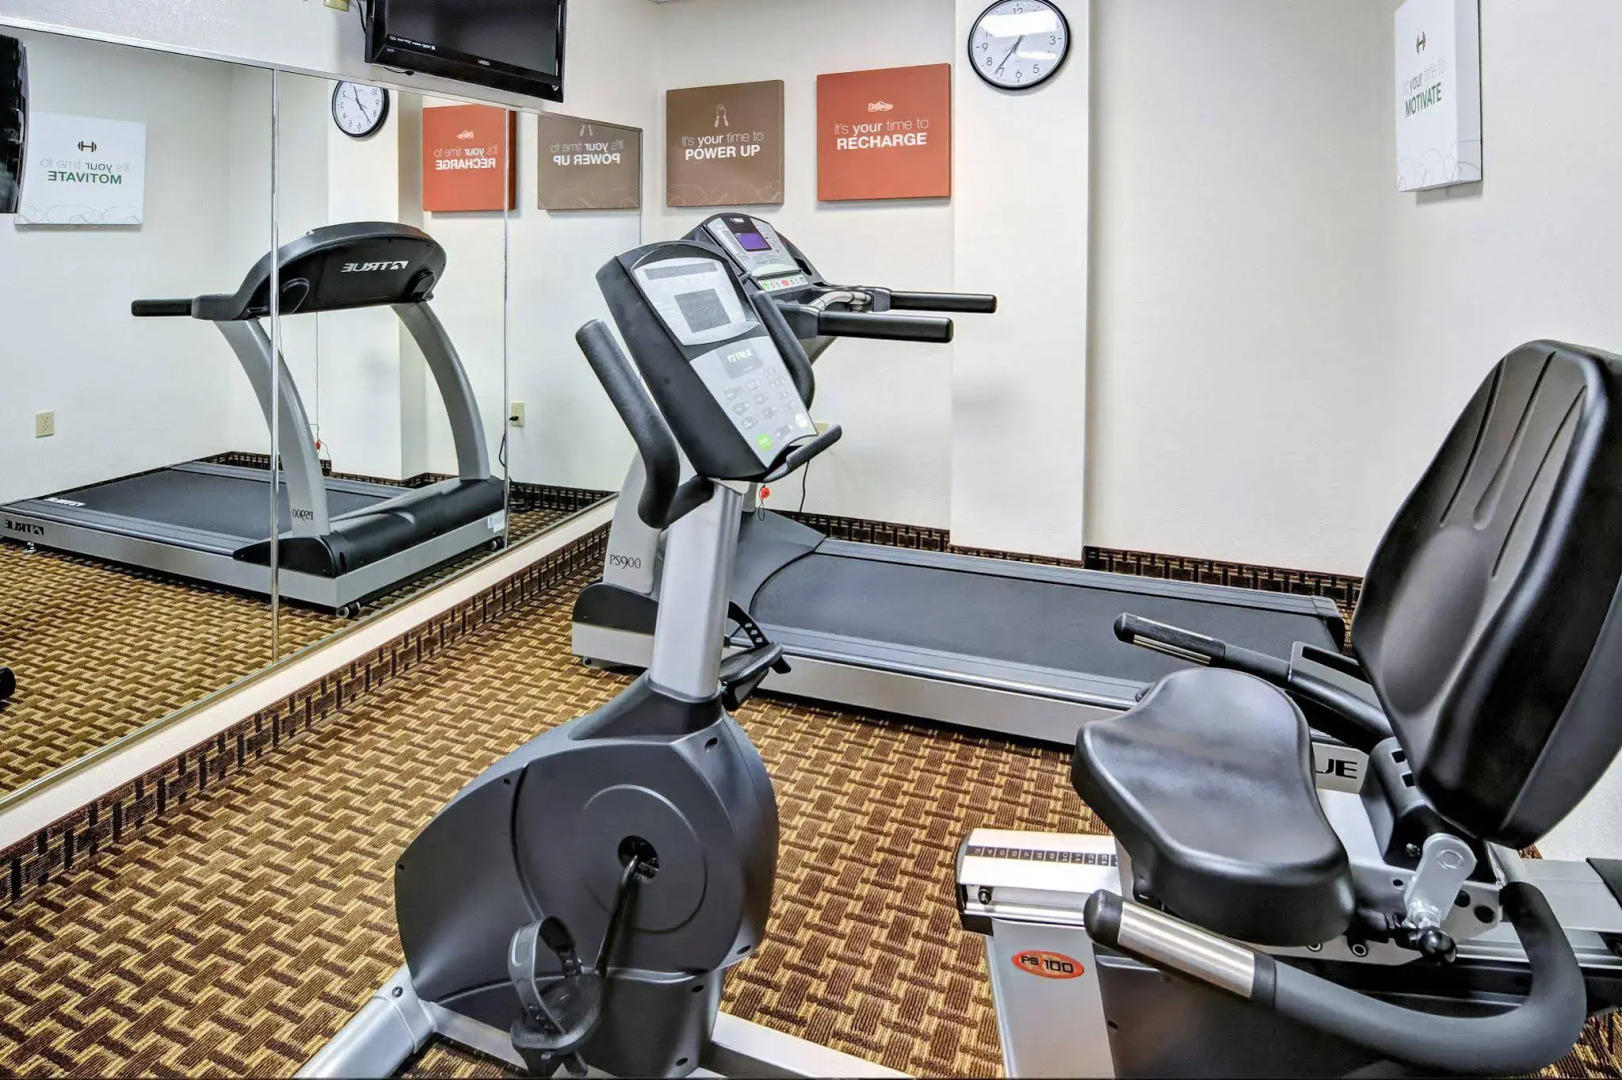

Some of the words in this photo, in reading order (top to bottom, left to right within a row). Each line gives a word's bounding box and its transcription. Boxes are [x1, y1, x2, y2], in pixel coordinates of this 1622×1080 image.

[1049, 35, 1056, 45] 3
[981, 42, 989, 52] 9
[986, 56, 993, 66] 8
[1015, 69, 1022, 79] 6
[1032, 64, 1040, 74] 5
[1405, 81, 1442, 118] MOTIVATE
[852, 123, 883, 137] your
[886, 119, 913, 132] time
[916, 117, 929, 129] to
[697, 135, 725, 148] your
[726, 131, 750, 143] time
[752, 130, 764, 142] to
[836, 132, 928, 151] RECHARGE
[685, 146, 736, 161] POWER
[740, 144, 761, 157] UP
[609, 553, 642, 570] PS900
[1062, 852, 1068, 862] 10
[1075, 853, 1082, 863] 11
[1088, 854, 1095, 864] 12
[1101, 854, 1108, 864] 13
[1020, 955, 1040, 967] PS
[1044, 958, 1075, 974] 100
